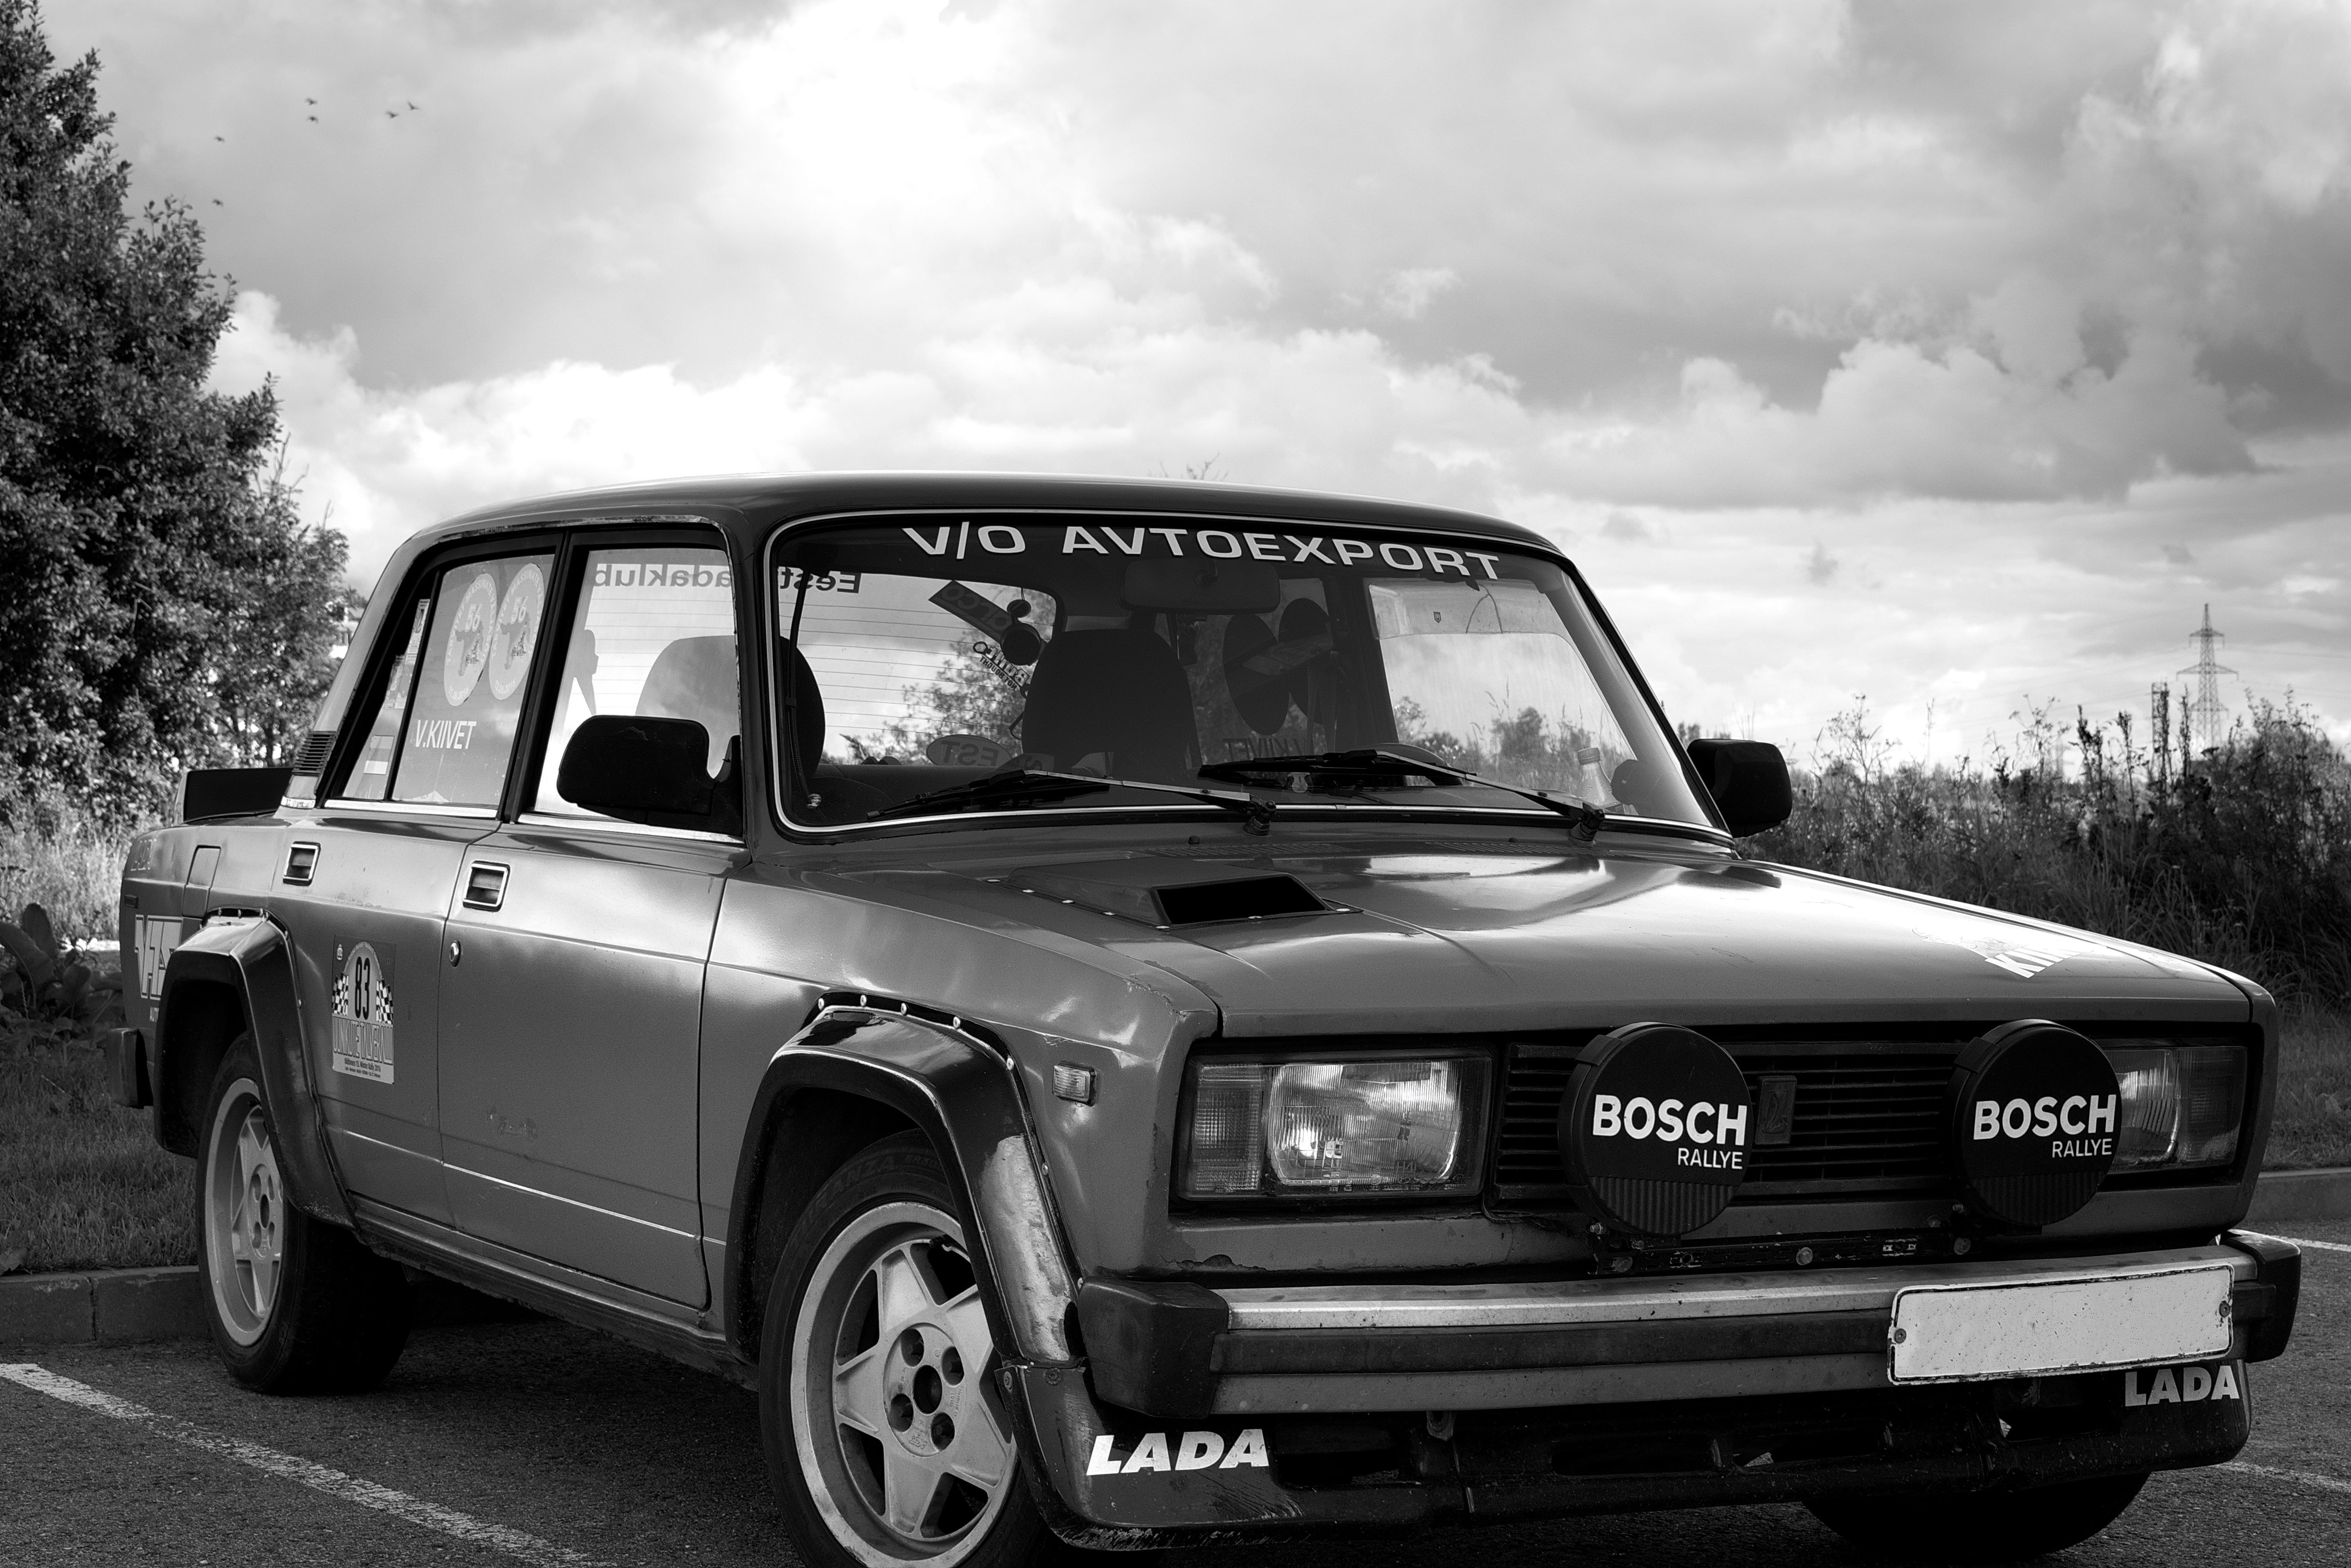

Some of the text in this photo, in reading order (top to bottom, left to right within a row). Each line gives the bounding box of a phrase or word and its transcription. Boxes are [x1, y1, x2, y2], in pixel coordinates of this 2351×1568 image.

[902, 521, 1500, 580] V/O AVTOEXPORT
[464, 604, 483, 632] 56
[510, 596, 529, 624] 56
[416, 719, 477, 749] V.KIIVET
[355, 956, 370, 1020] 83
[1593, 1094, 1748, 1146] BOSCH
[1973, 1094, 2117, 1140] BOSCH
[1678, 1148, 1743, 1169] RALLYE
[2052, 1138, 2113, 1158] RALLYE
[2125, 1365, 2240, 1407] LADA
[1086, 1429, 1269, 1476] LADA
